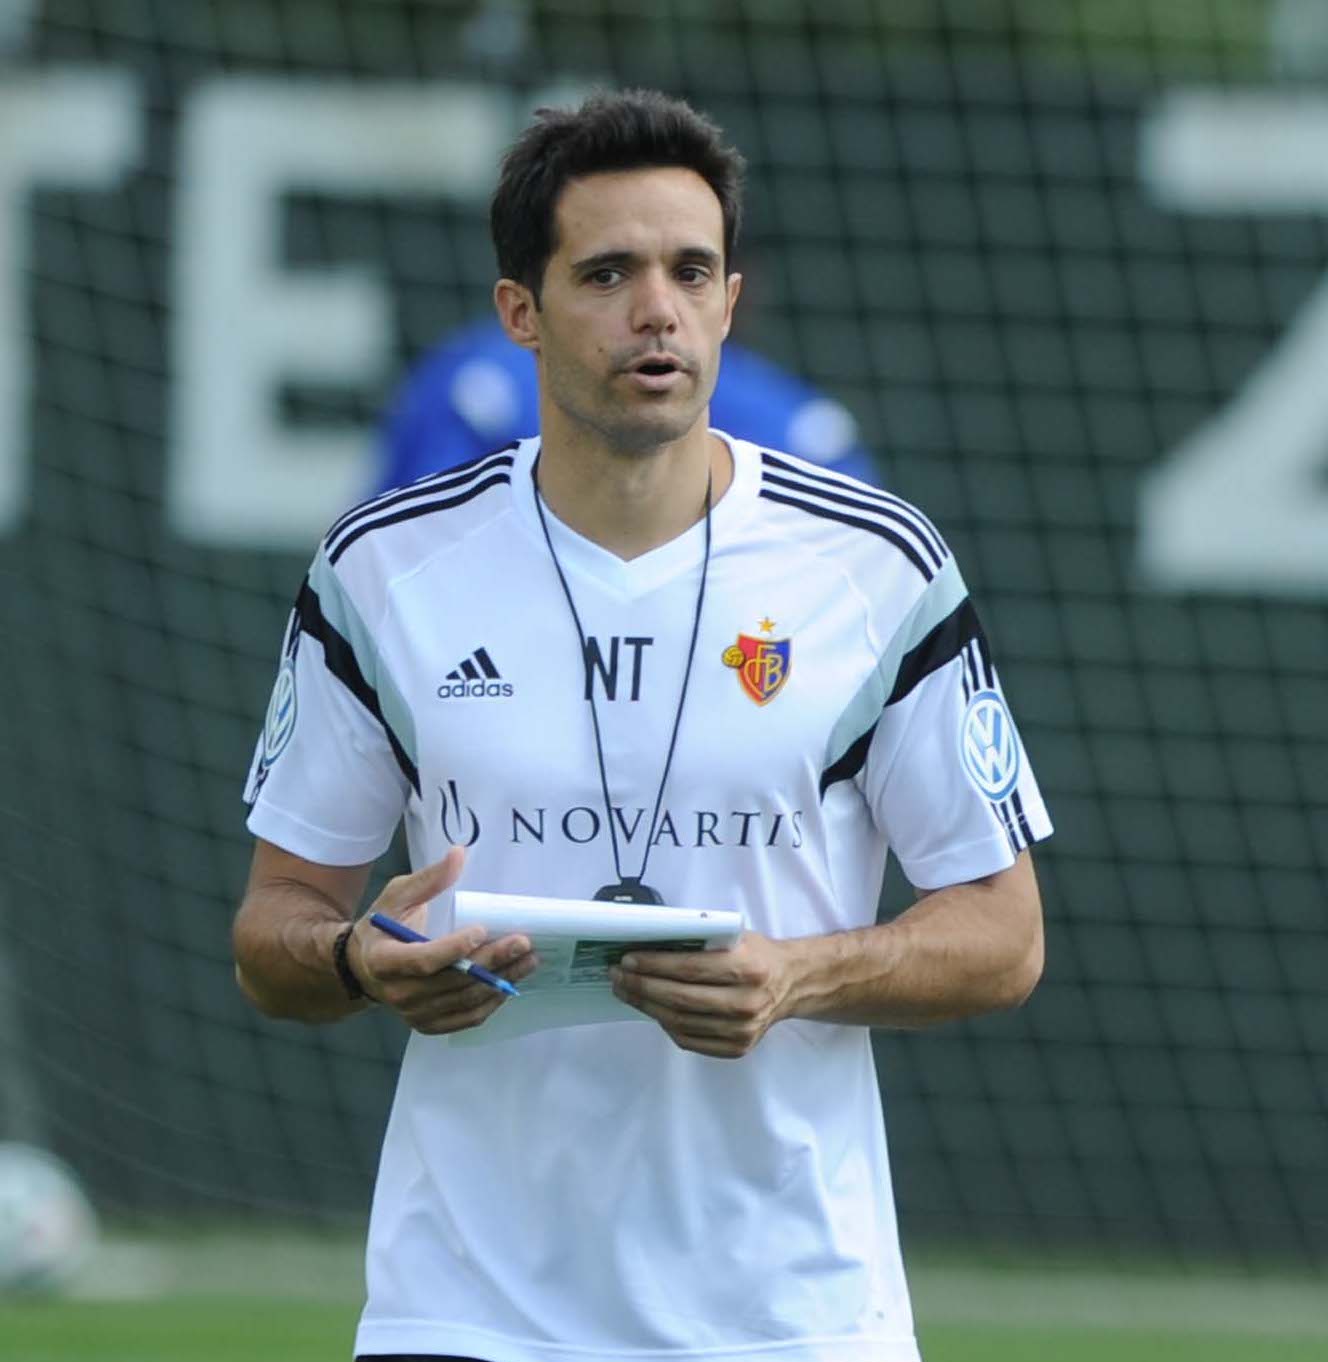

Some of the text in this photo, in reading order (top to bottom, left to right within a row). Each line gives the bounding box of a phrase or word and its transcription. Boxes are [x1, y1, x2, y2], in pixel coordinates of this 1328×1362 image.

[437, 679, 514, 698] adidas
[584, 636, 654, 701] NT
[510, 805, 803, 849] NOVARTIS
